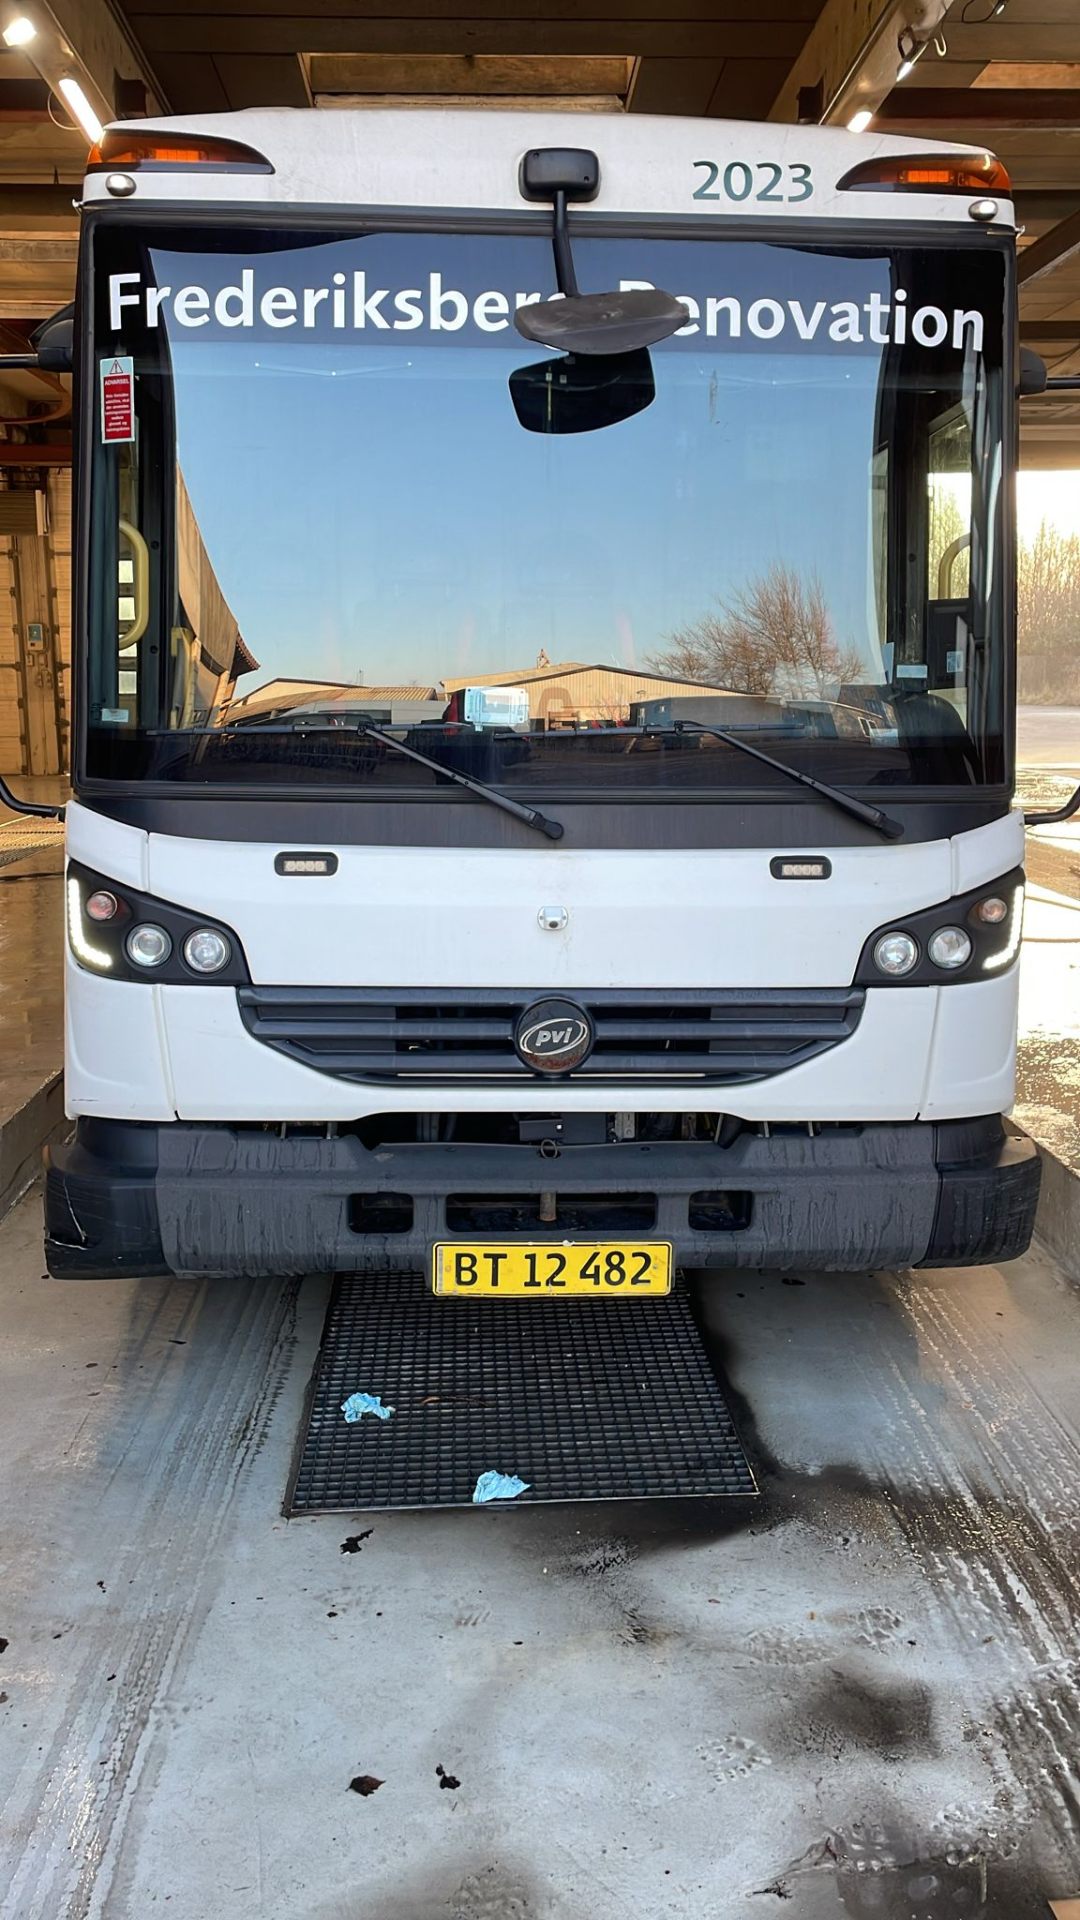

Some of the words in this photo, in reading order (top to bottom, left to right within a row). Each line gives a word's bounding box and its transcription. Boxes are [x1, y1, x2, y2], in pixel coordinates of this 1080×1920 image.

[692, 160, 814, 203] 2023
[109, 269, 568, 351] Frederiksber
[619, 280, 984, 352] enovation
[535, 1027, 573, 1046] pvi
[455, 1252, 508, 1287] BT
[523, 1252, 567, 1287] 12
[579, 1250, 652, 1286] 482
